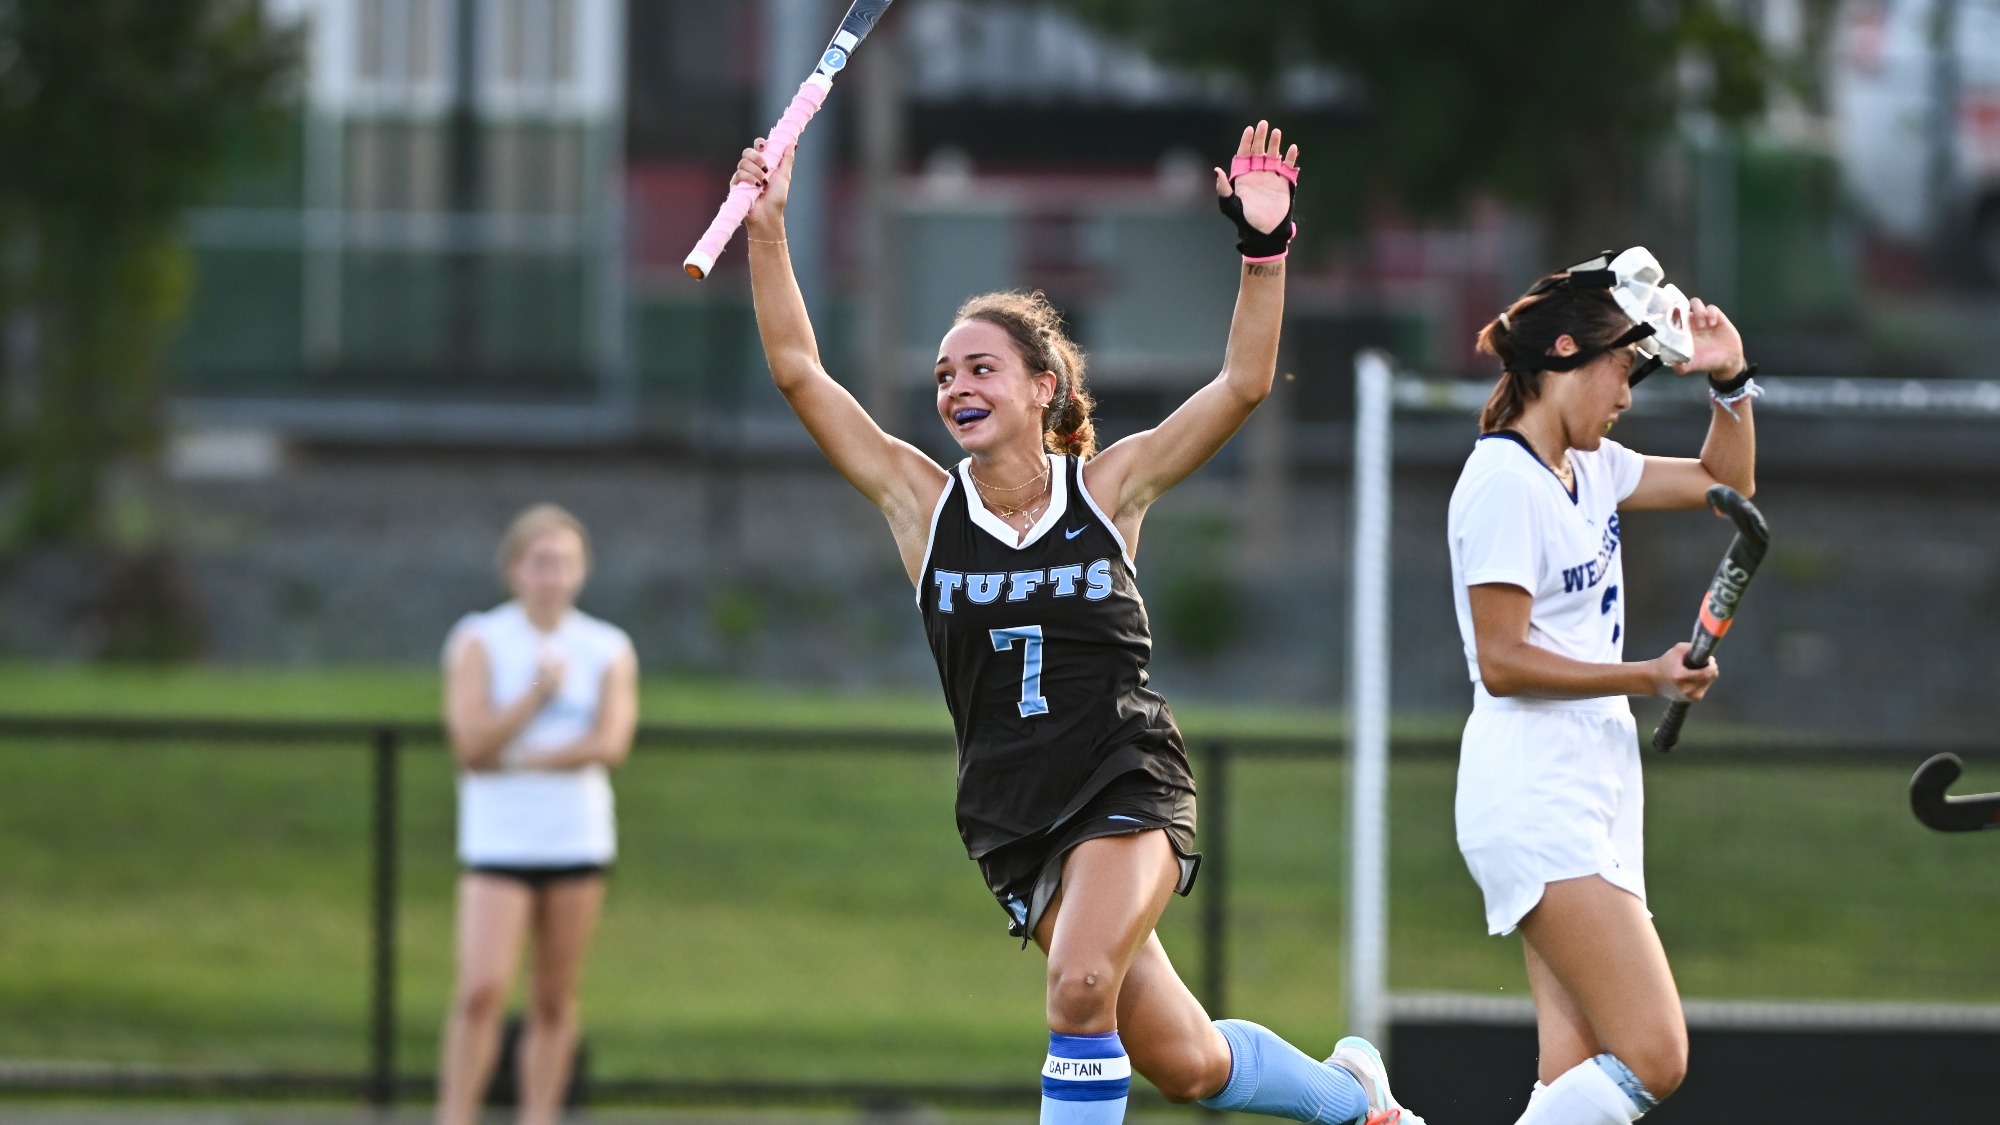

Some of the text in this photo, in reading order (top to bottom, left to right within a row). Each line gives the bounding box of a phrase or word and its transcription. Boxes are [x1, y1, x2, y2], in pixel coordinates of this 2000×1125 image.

[828, 52, 840, 66] 2
[934, 558, 1114, 613] TUFTS
[989, 625, 1049, 718] 7
[1049, 1060, 1102, 1076] CAPTAIN
